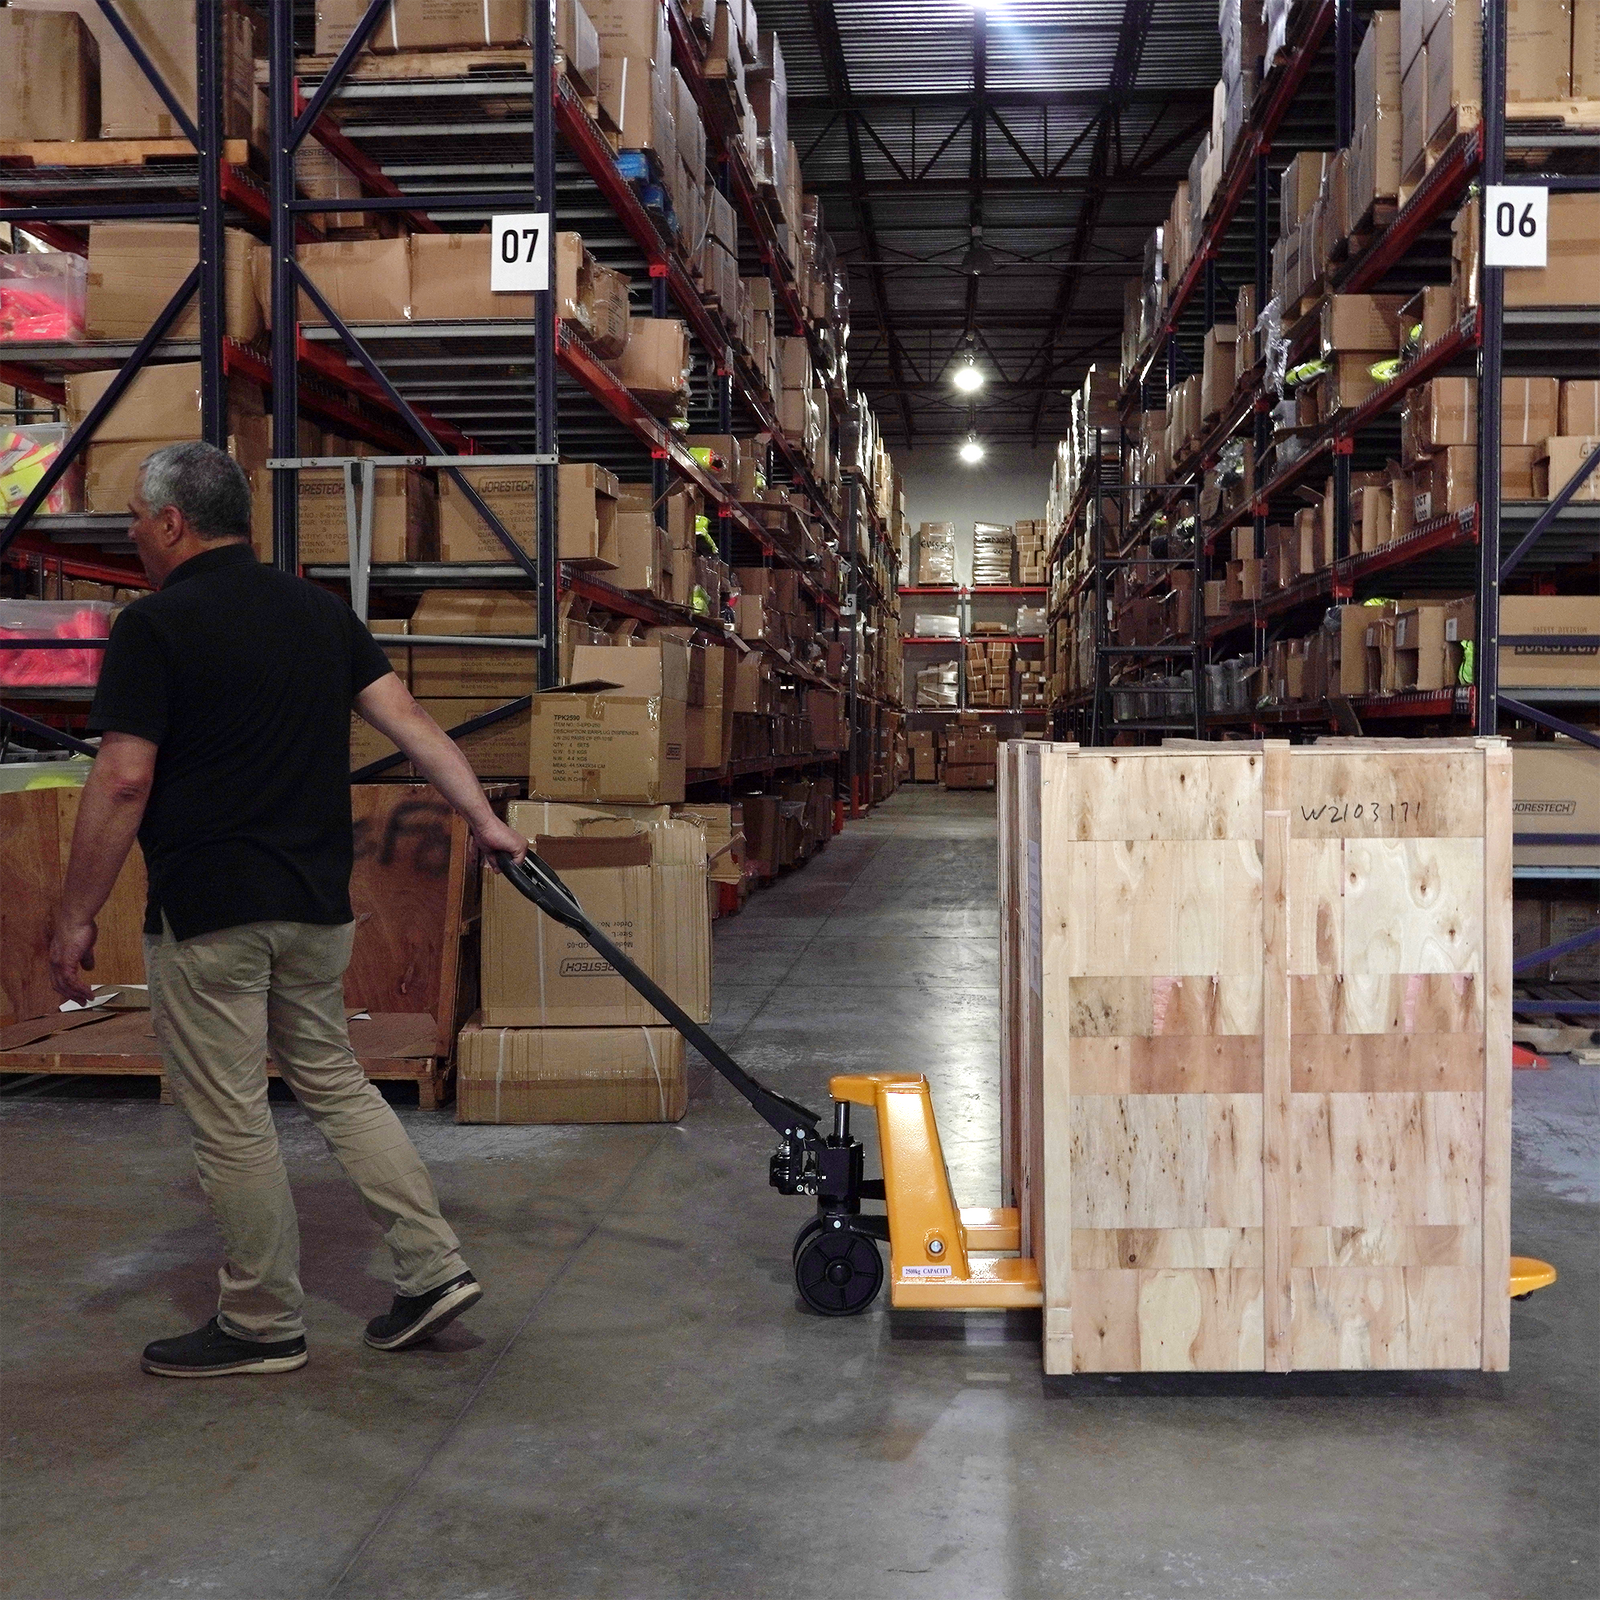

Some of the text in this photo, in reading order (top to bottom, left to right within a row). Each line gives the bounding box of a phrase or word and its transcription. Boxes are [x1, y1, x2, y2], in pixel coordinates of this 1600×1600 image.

[1496, 202, 1536, 237] 06
[502, 229, 539, 263] 07
[298, 484, 346, 495] ORESTECH
[482, 481, 535, 493] JORESTECH
[1300, 801, 1421, 824] W2103171
[1512, 803, 1571, 813] JORESTECH
[613, 921, 633, 929] Order
[566, 941, 590, 949] GD-05
[565, 962, 616, 972] RESTECH
[922, 1267, 949, 1275] CAPACITY
